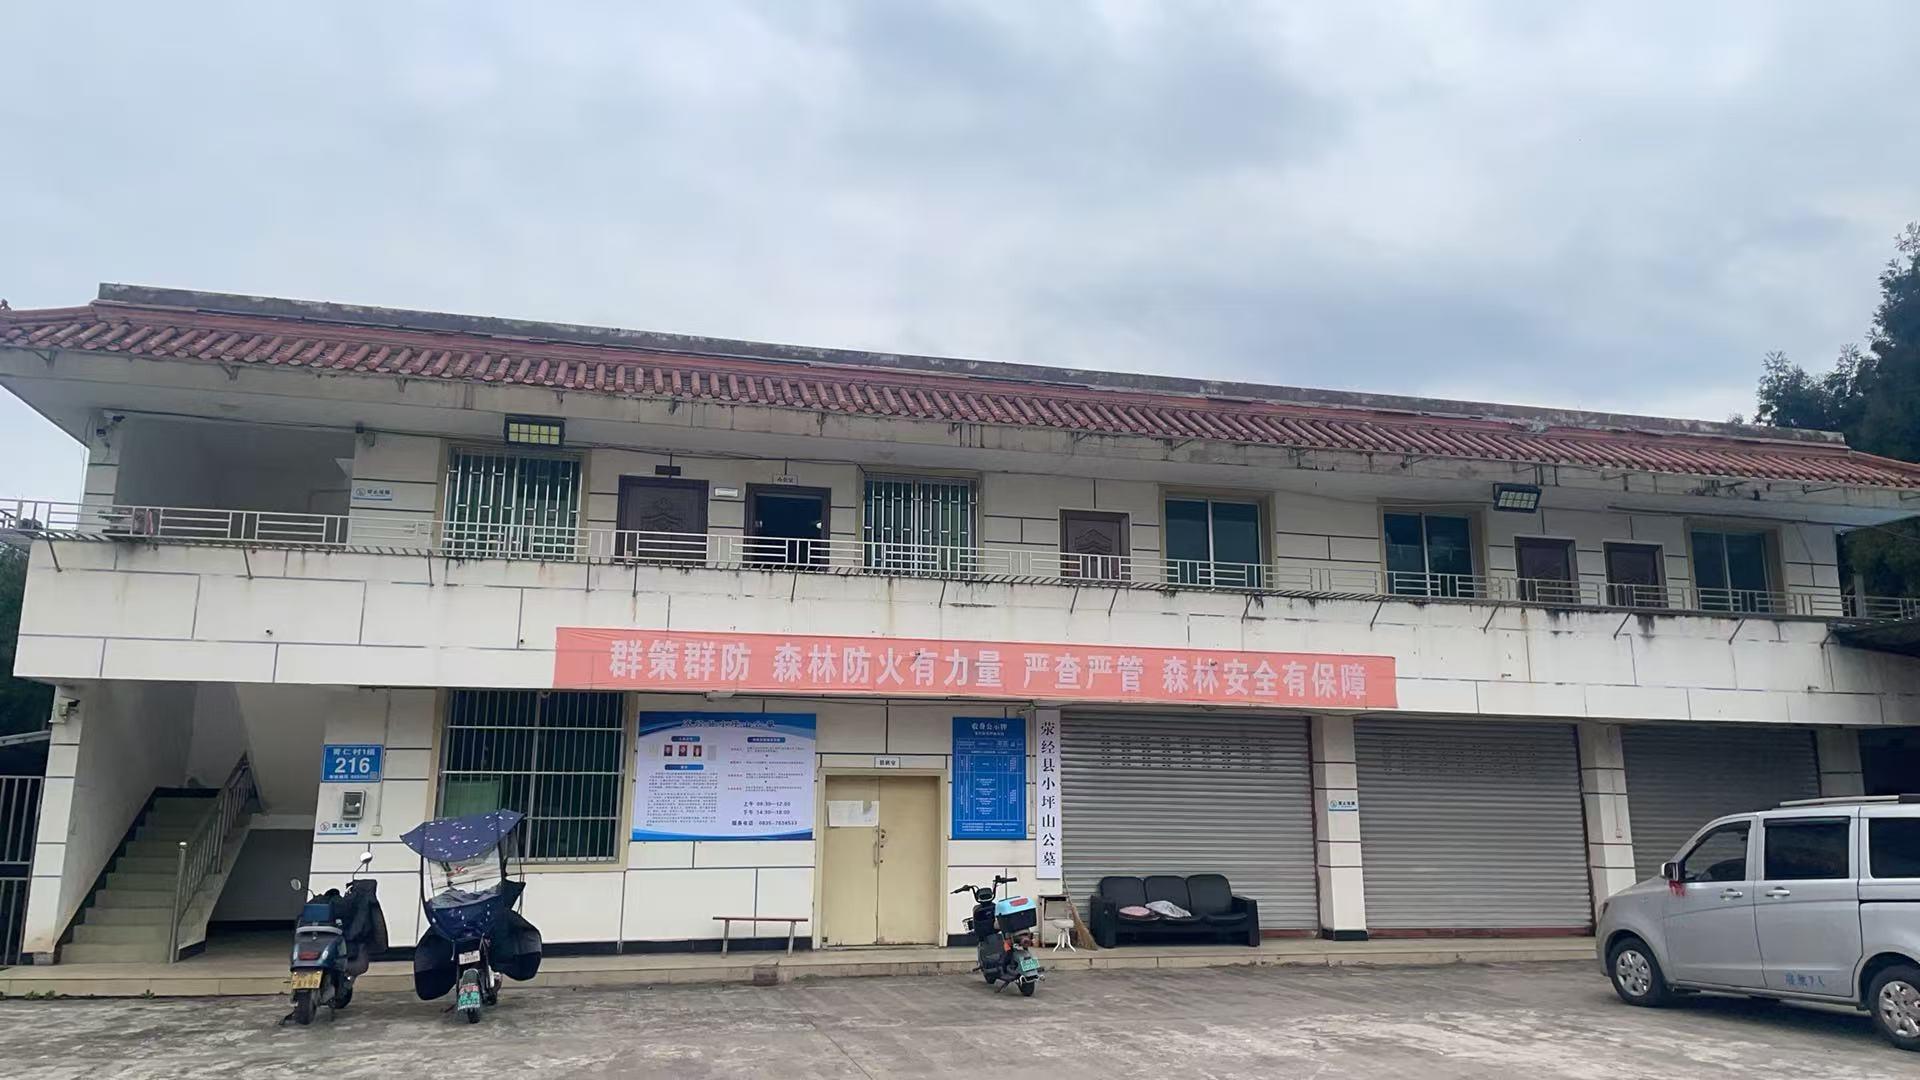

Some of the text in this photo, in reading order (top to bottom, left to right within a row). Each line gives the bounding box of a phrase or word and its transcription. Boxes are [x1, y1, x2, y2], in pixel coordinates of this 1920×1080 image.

[609, 639, 1369, 700] 群策群防 森林防火有力量 严查严管 森林安全有保障
[334, 757, 371, 774] 216
[1040, 720, 1056, 867] 荥经县小坪山公墓
